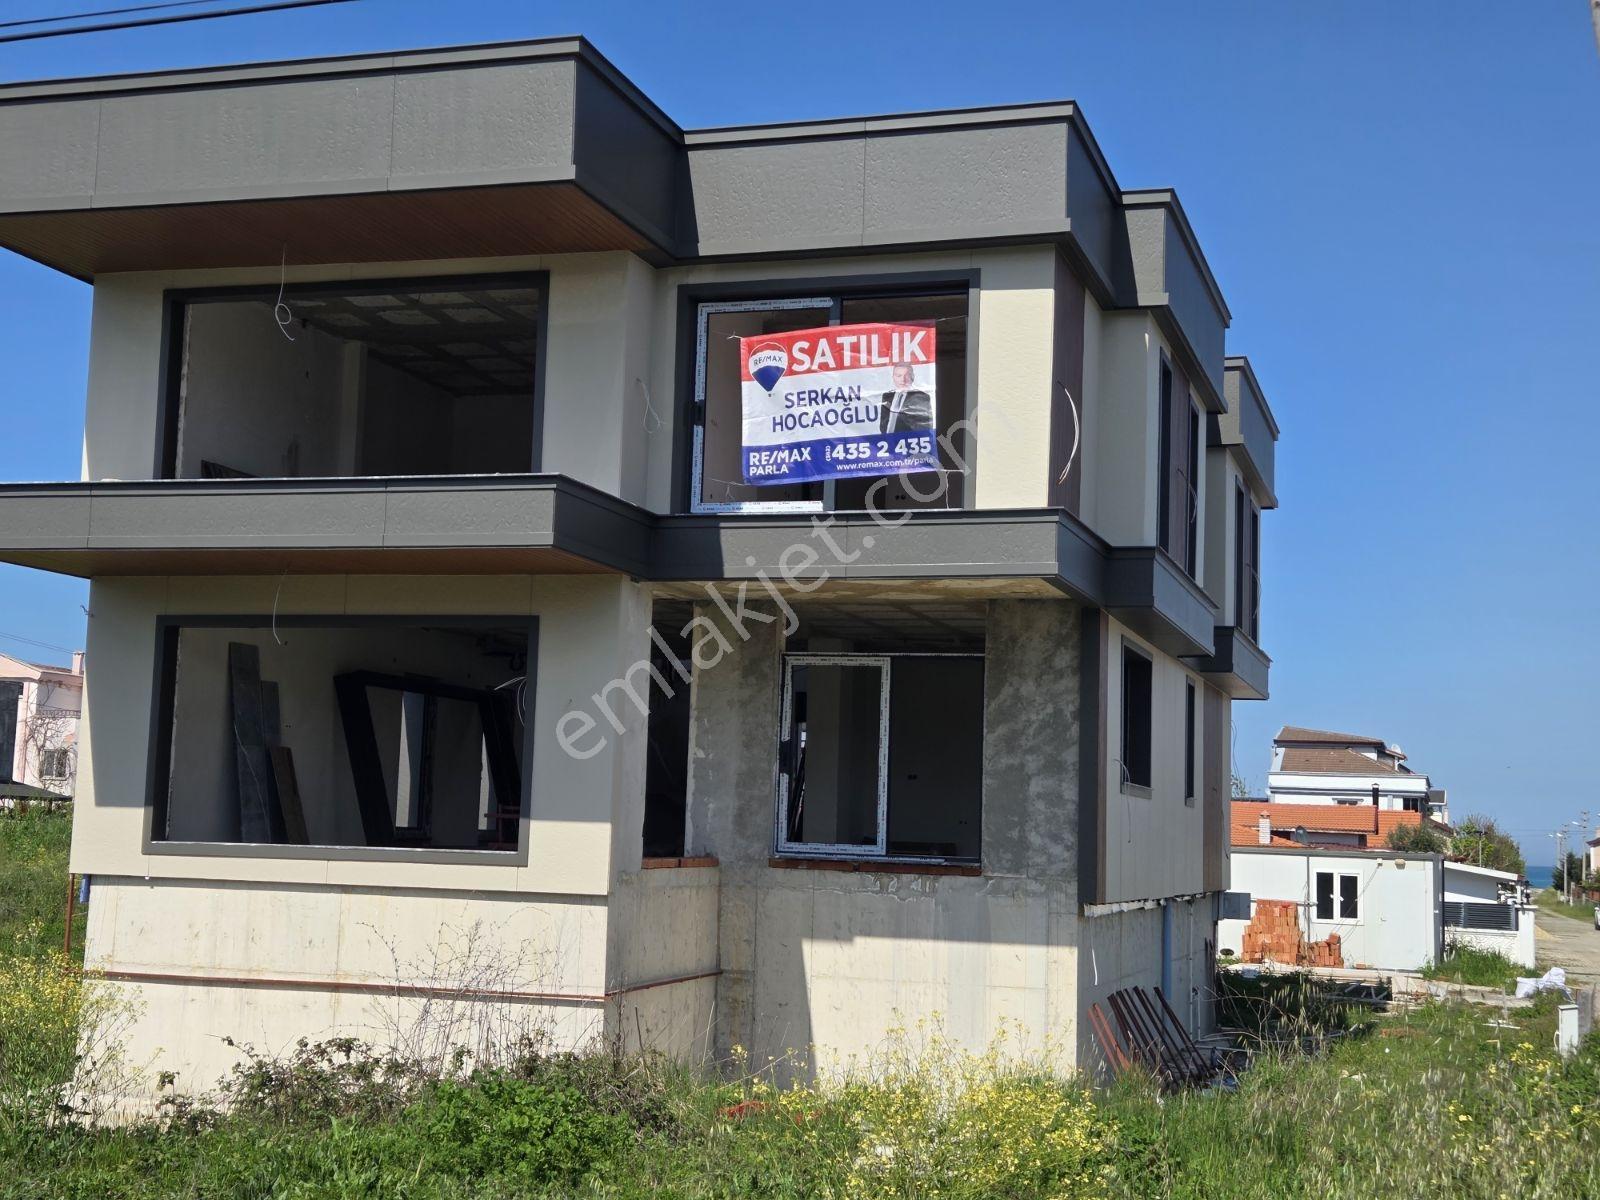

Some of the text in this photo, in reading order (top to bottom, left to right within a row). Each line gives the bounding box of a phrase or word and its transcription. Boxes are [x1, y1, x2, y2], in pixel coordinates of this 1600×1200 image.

[753, 354, 783, 366] RE/MAX
[791, 331, 927, 372] SATILIK
[784, 385, 862, 409] SERKAN
[772, 403, 879, 433] HOCAOĞLU
[750, 447, 811, 466] RE/MAX
[832, 442, 871, 460] 435
[876, 441, 890, 458] 2
[894, 437, 932, 455] 435
[749, 464, 789, 476] PARLA
